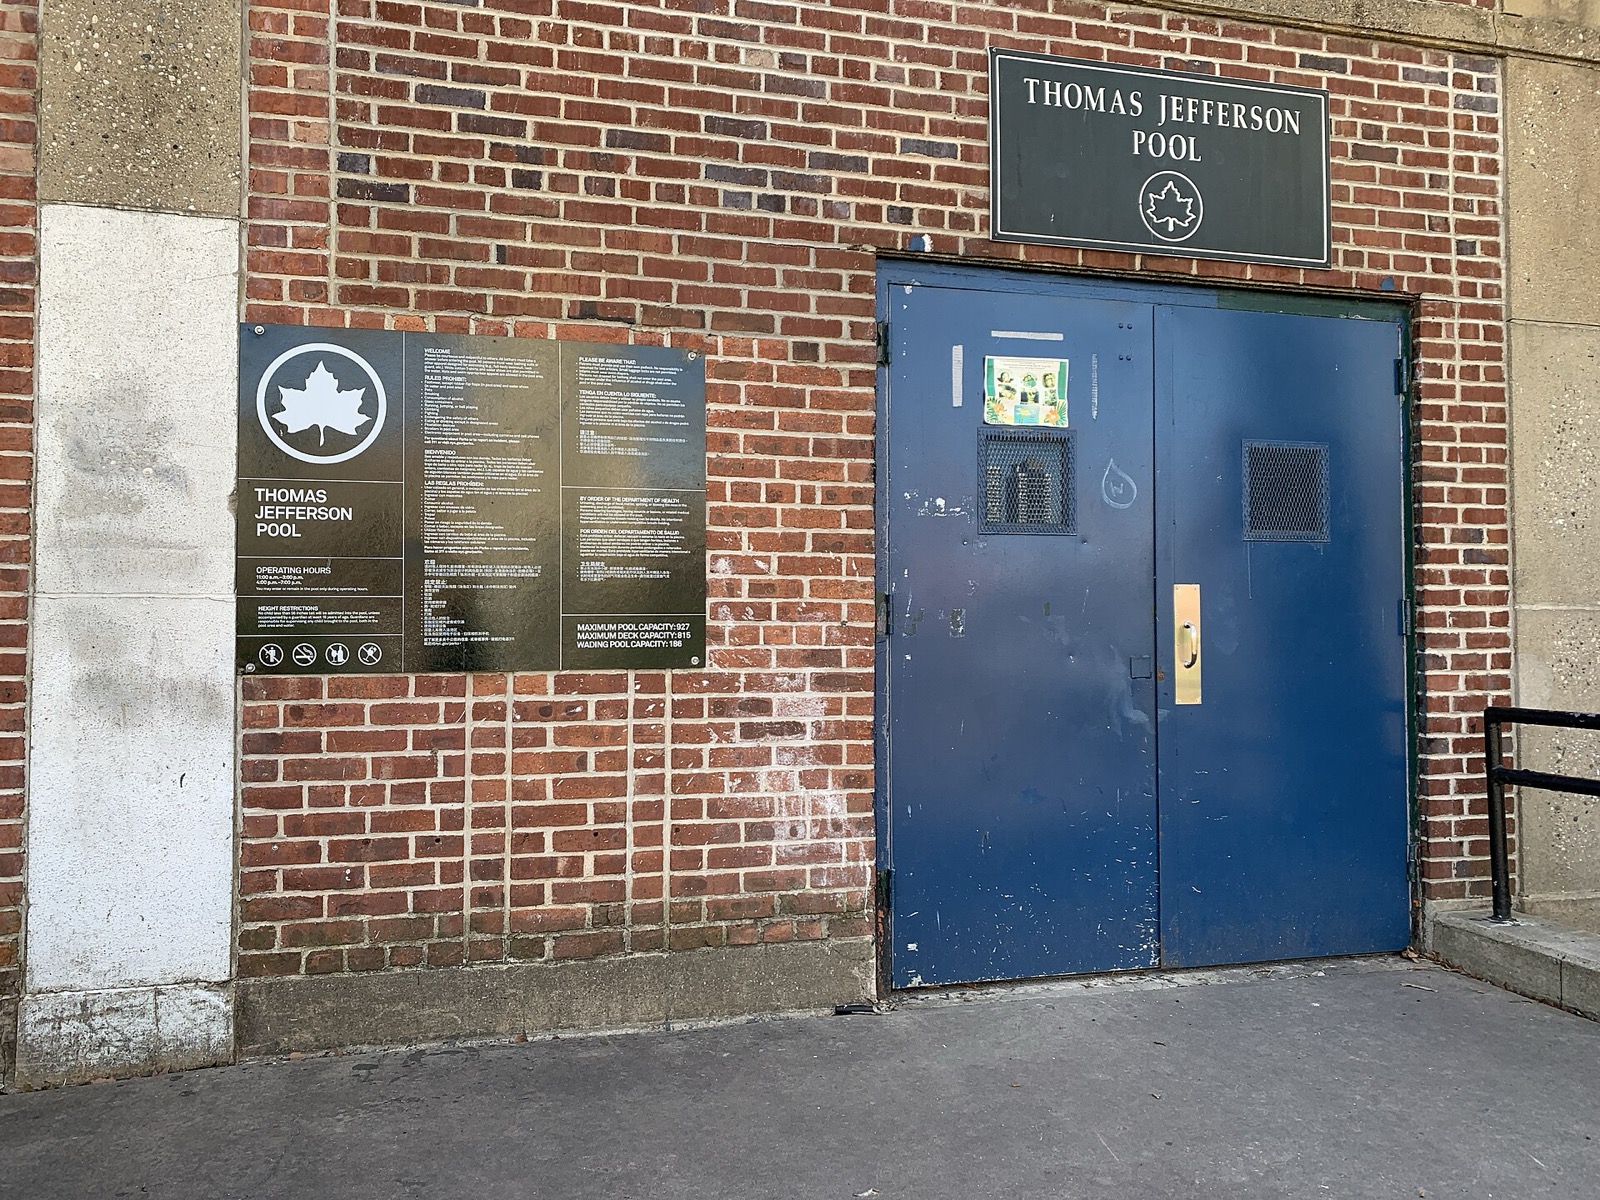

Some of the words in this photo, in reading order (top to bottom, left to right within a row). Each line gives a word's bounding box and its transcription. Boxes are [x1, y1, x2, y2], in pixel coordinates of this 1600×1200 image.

[1024, 78, 1143, 117] THOMAS
[1158, 94, 1300, 135] JEFFERSON
[1132, 130, 1201, 162] POOL
[254, 488, 327, 503] THOMAS
[254, 505, 353, 521] JEFFERSON
[256, 523, 301, 537] POOL
[256, 566, 301, 574] OPERATING
[303, 566, 332, 574] HOURS
[577, 623, 616, 631] MAXIMUM
[618, 623, 638, 631] POOL
[676, 622, 690, 631] 927
[577, 632, 616, 640] MAXIMUM
[618, 632, 639, 640] DECK
[576, 640, 608, 648] WADING
[610, 640, 630, 648] POOL
